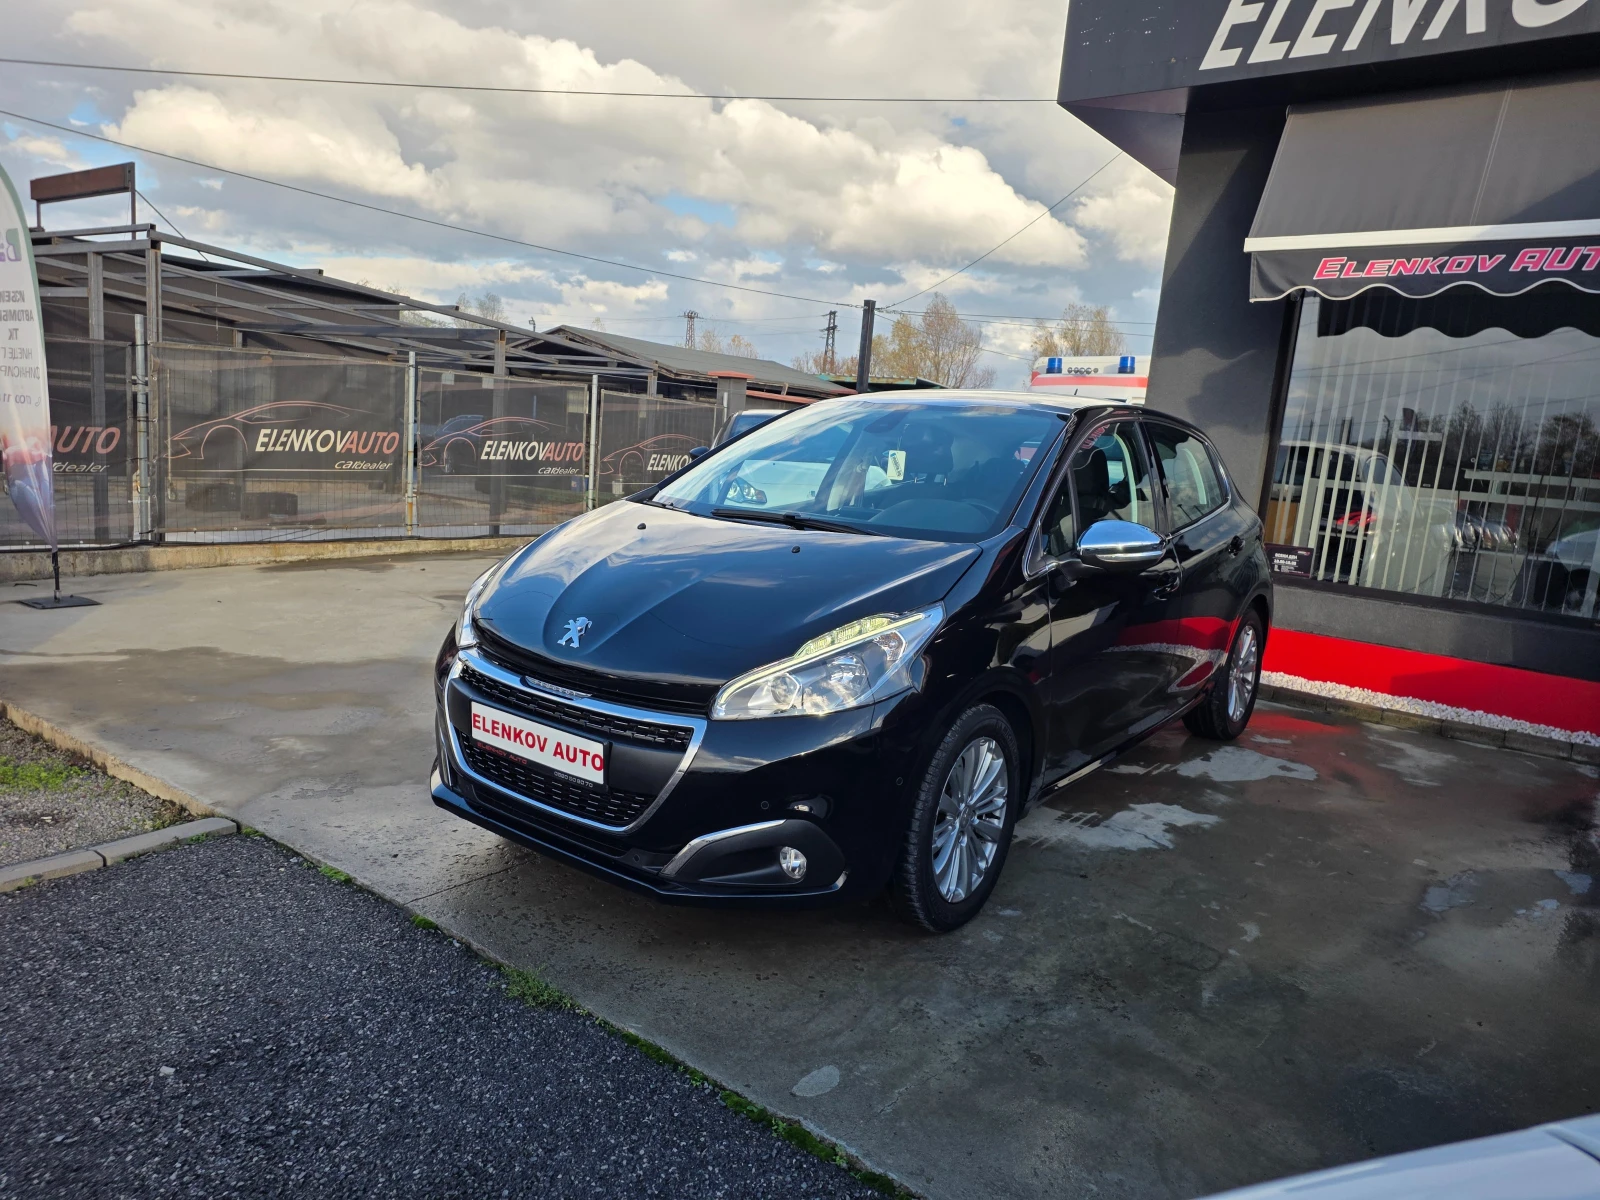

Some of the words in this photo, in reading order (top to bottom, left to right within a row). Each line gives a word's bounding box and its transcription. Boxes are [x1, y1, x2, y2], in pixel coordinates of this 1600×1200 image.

[1199, 0, 1588, 71] ELEN
[1313, 254, 1506, 280] ELENKOV
[647, 453, 692, 471] ELENKO
[472, 712, 548, 753] ELENKOV
[552, 741, 605, 772] AUTO
